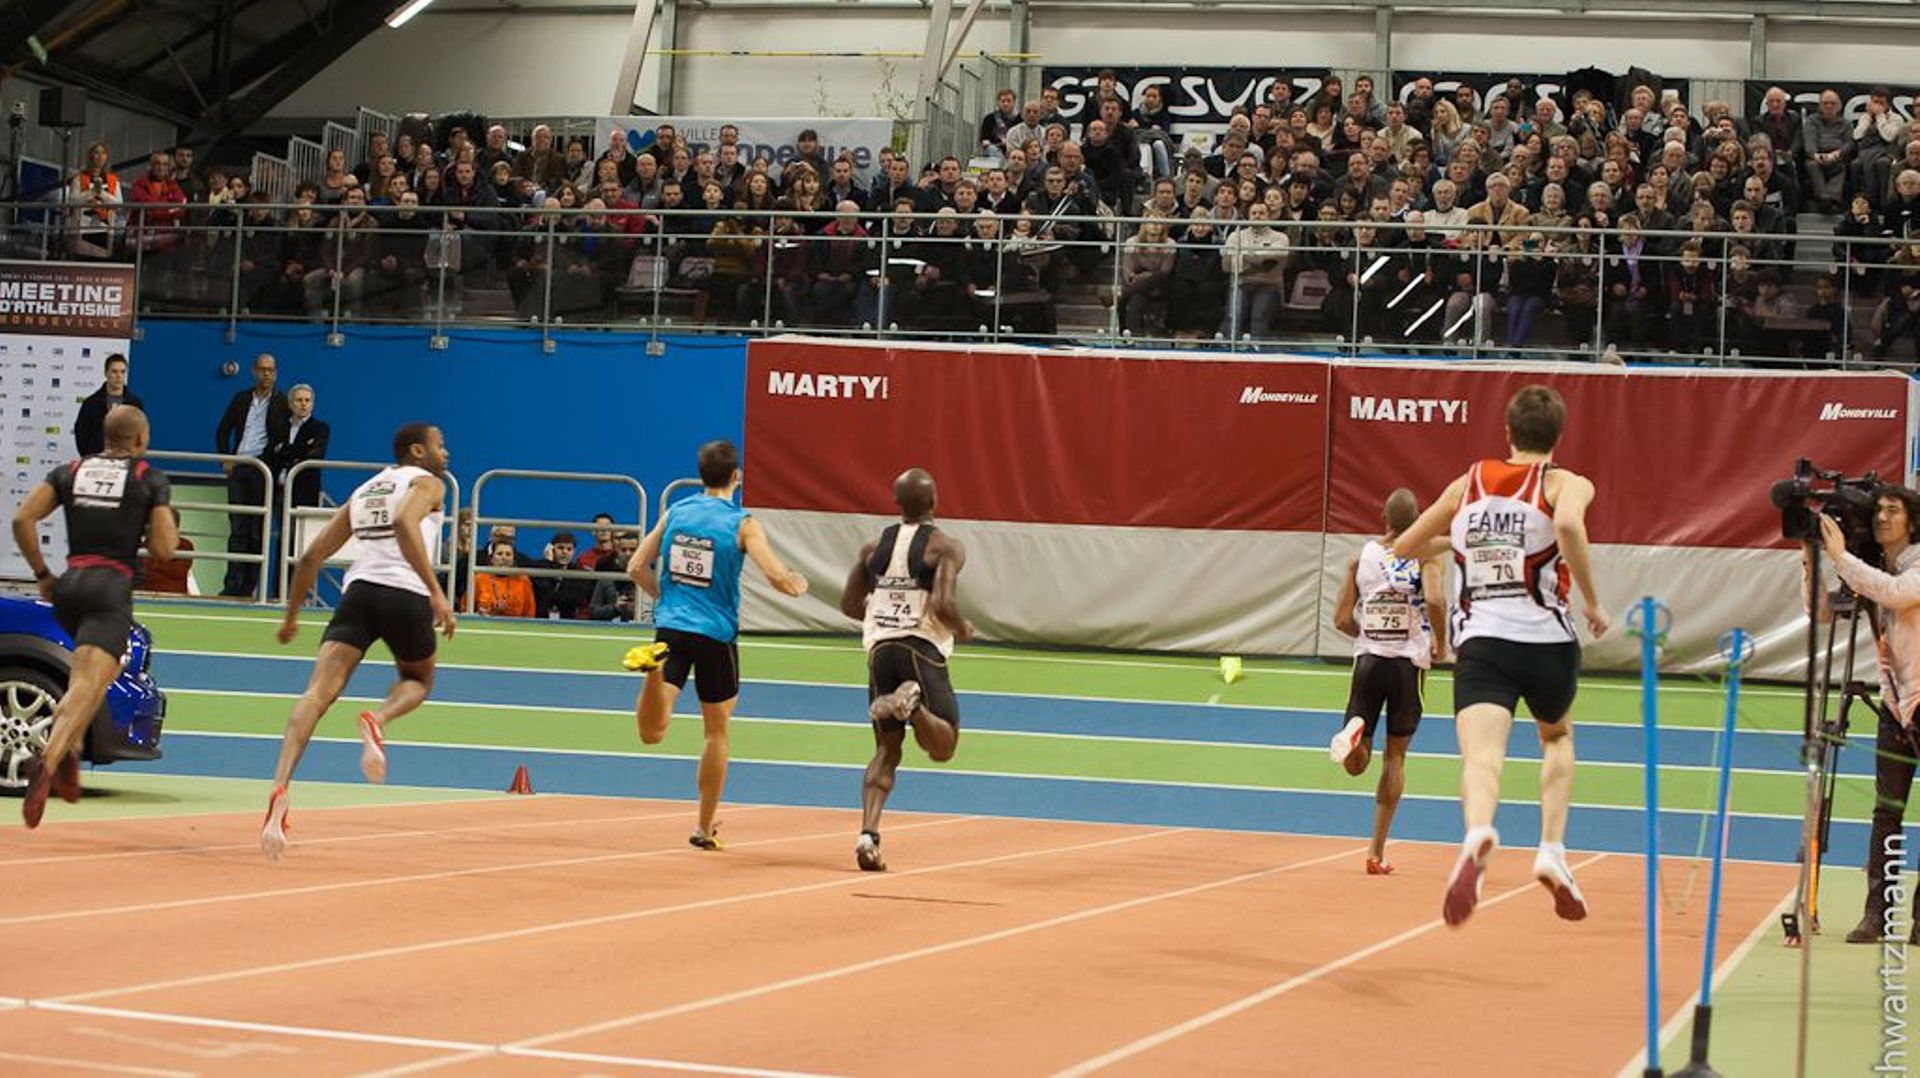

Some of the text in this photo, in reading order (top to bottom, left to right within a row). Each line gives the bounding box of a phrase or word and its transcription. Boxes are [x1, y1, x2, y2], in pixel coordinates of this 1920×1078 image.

[683, 127, 718, 141] VILLE
[0, 282, 122, 302] MEETING
[0, 300, 121, 317] D'ATHLETISME
[768, 371, 882, 399] MARTY
[1351, 397, 1461, 423] MARTY
[94, 481, 115, 494] 77
[371, 510, 389, 525] 78
[686, 561, 704, 576] 69
[1492, 564, 1515, 581] 70
[891, 603, 912, 616] 74
[1381, 616, 1401, 628] 75
